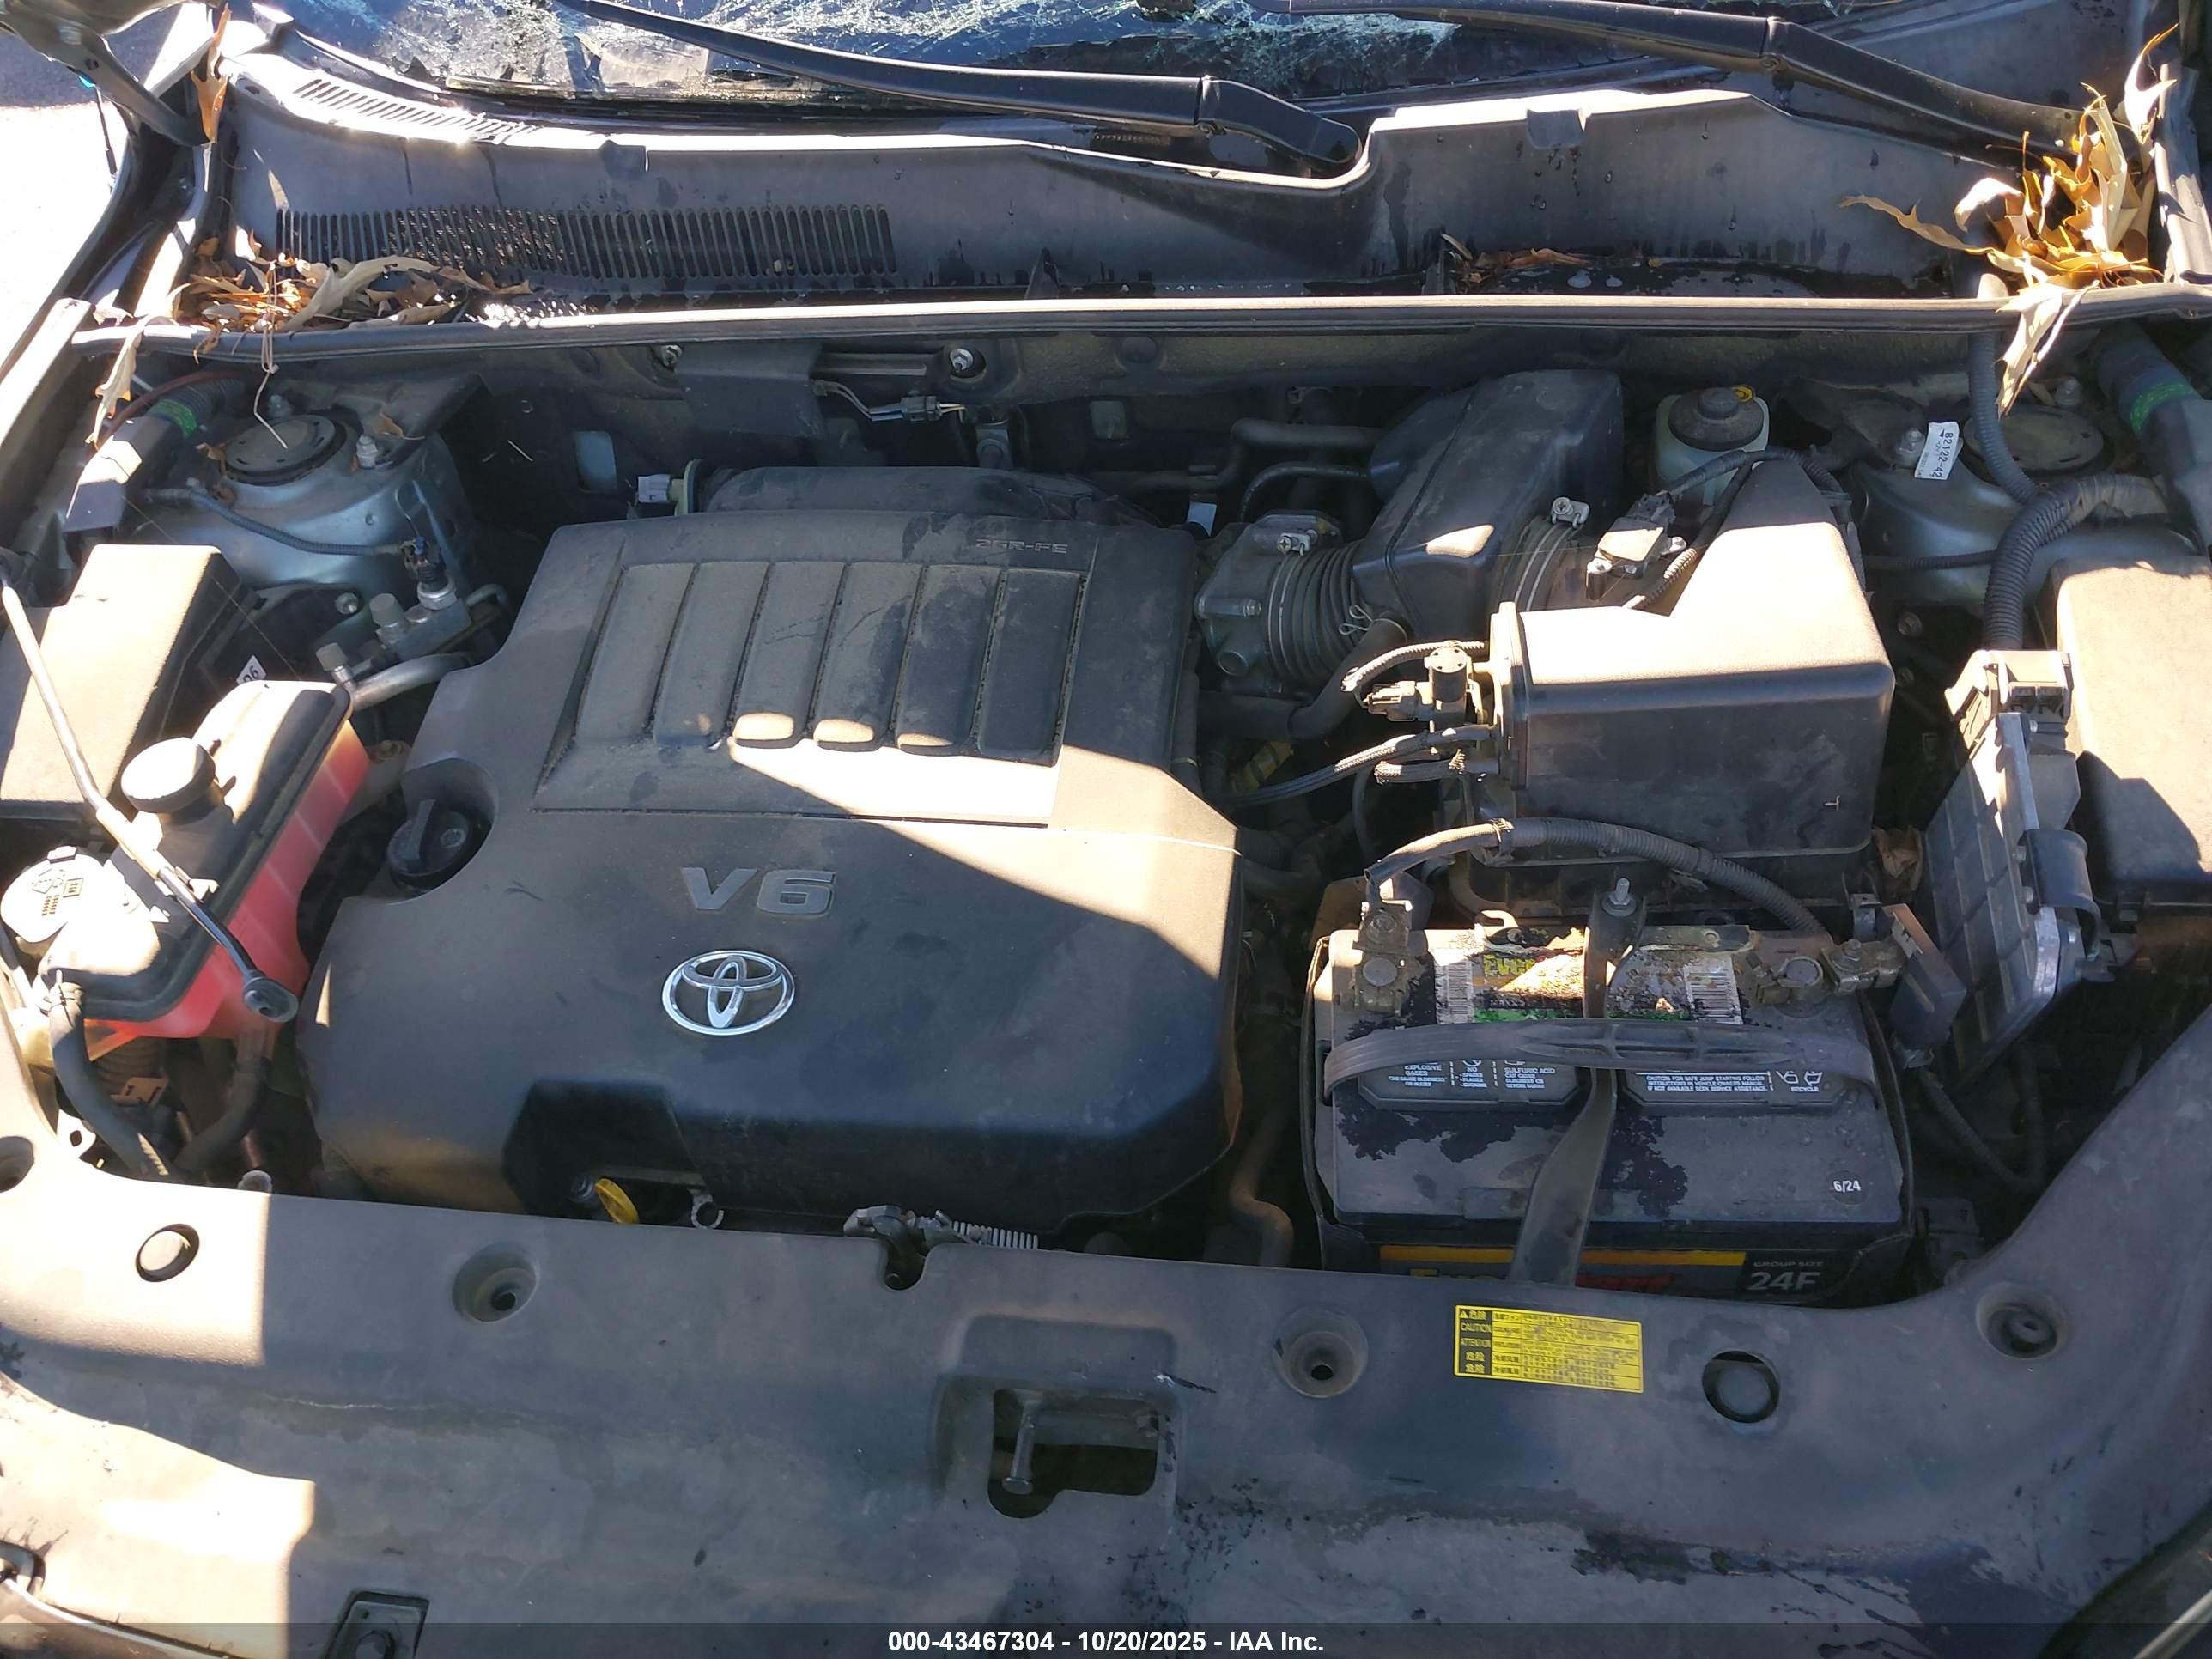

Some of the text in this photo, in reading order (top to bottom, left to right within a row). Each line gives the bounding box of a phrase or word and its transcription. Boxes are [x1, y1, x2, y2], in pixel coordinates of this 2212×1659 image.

[681, 866, 836, 916] V6
[1833, 1180, 1862, 1193] 6/24
[1747, 1272, 1820, 1290] 24F
